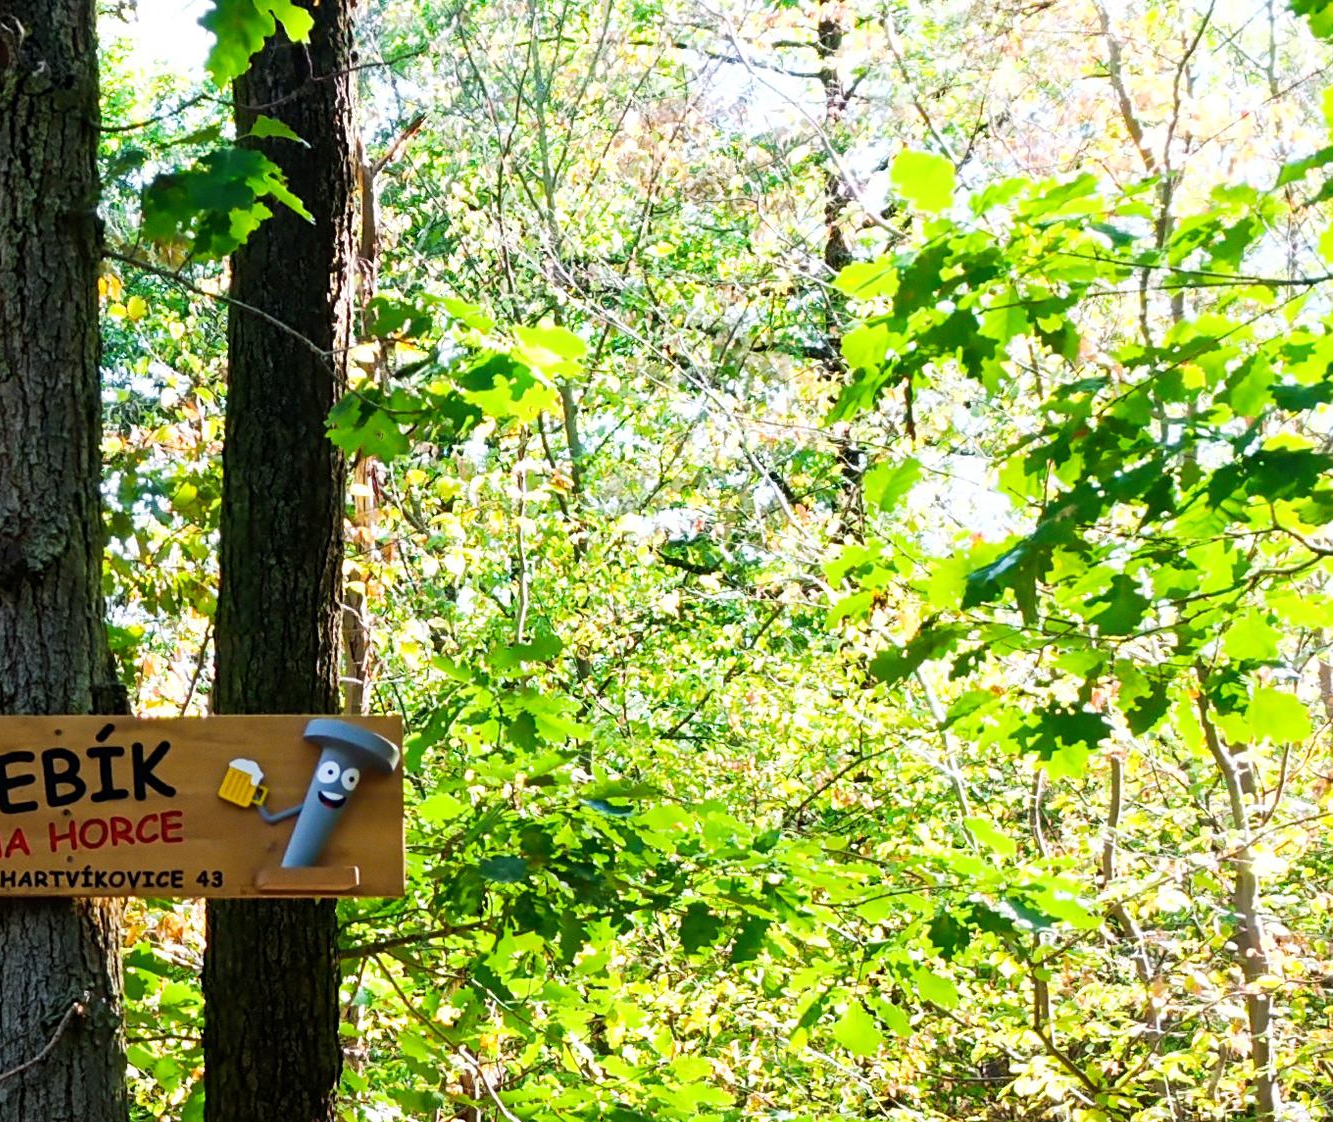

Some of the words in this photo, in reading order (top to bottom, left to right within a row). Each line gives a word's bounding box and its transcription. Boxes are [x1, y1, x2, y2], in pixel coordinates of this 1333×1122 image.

[48, 810, 184, 852] HORCE
[0, 865, 185, 889] HARTVÍKOVICE
[195, 871, 224, 889] 43
